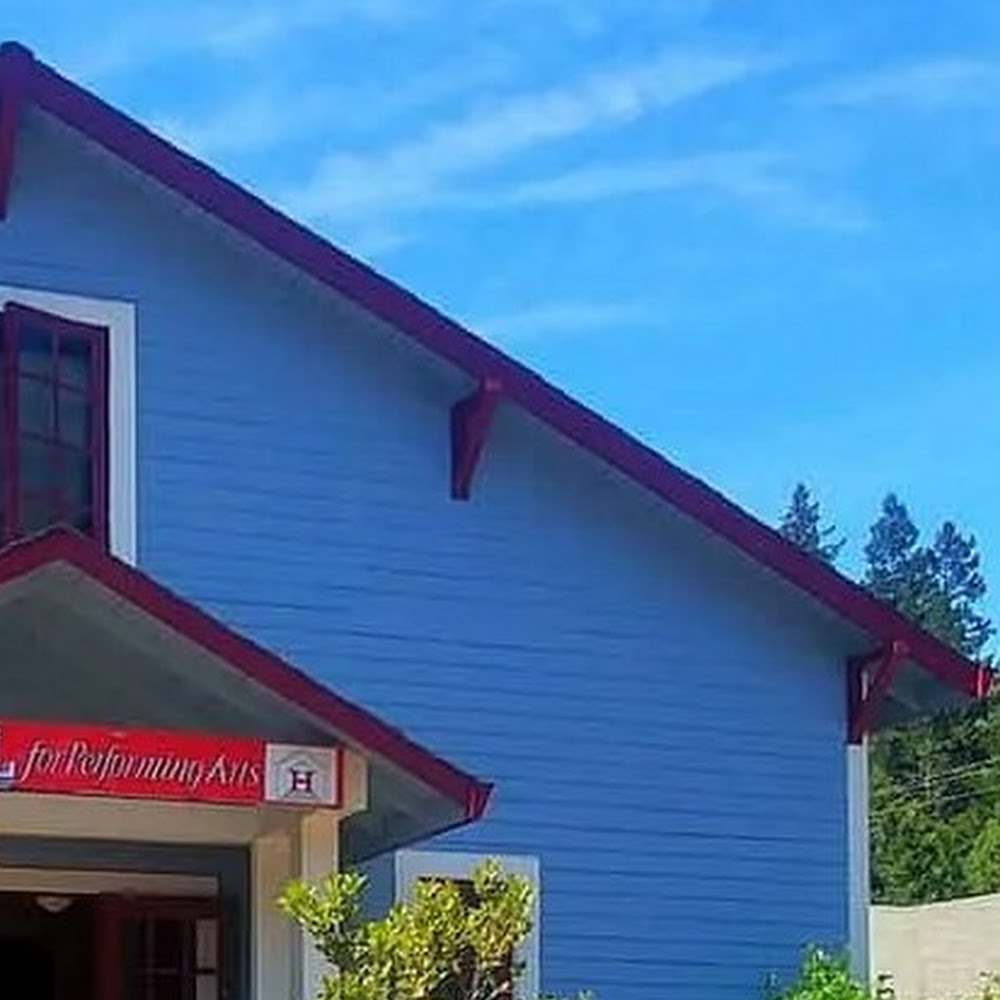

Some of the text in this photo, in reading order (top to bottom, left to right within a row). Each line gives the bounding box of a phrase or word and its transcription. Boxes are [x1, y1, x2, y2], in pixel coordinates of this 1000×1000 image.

[20, 739, 66, 783] for
[66, 740, 203, 791] Performing
[205, 753, 262, 785] Arts
[287, 766, 317, 797] H
